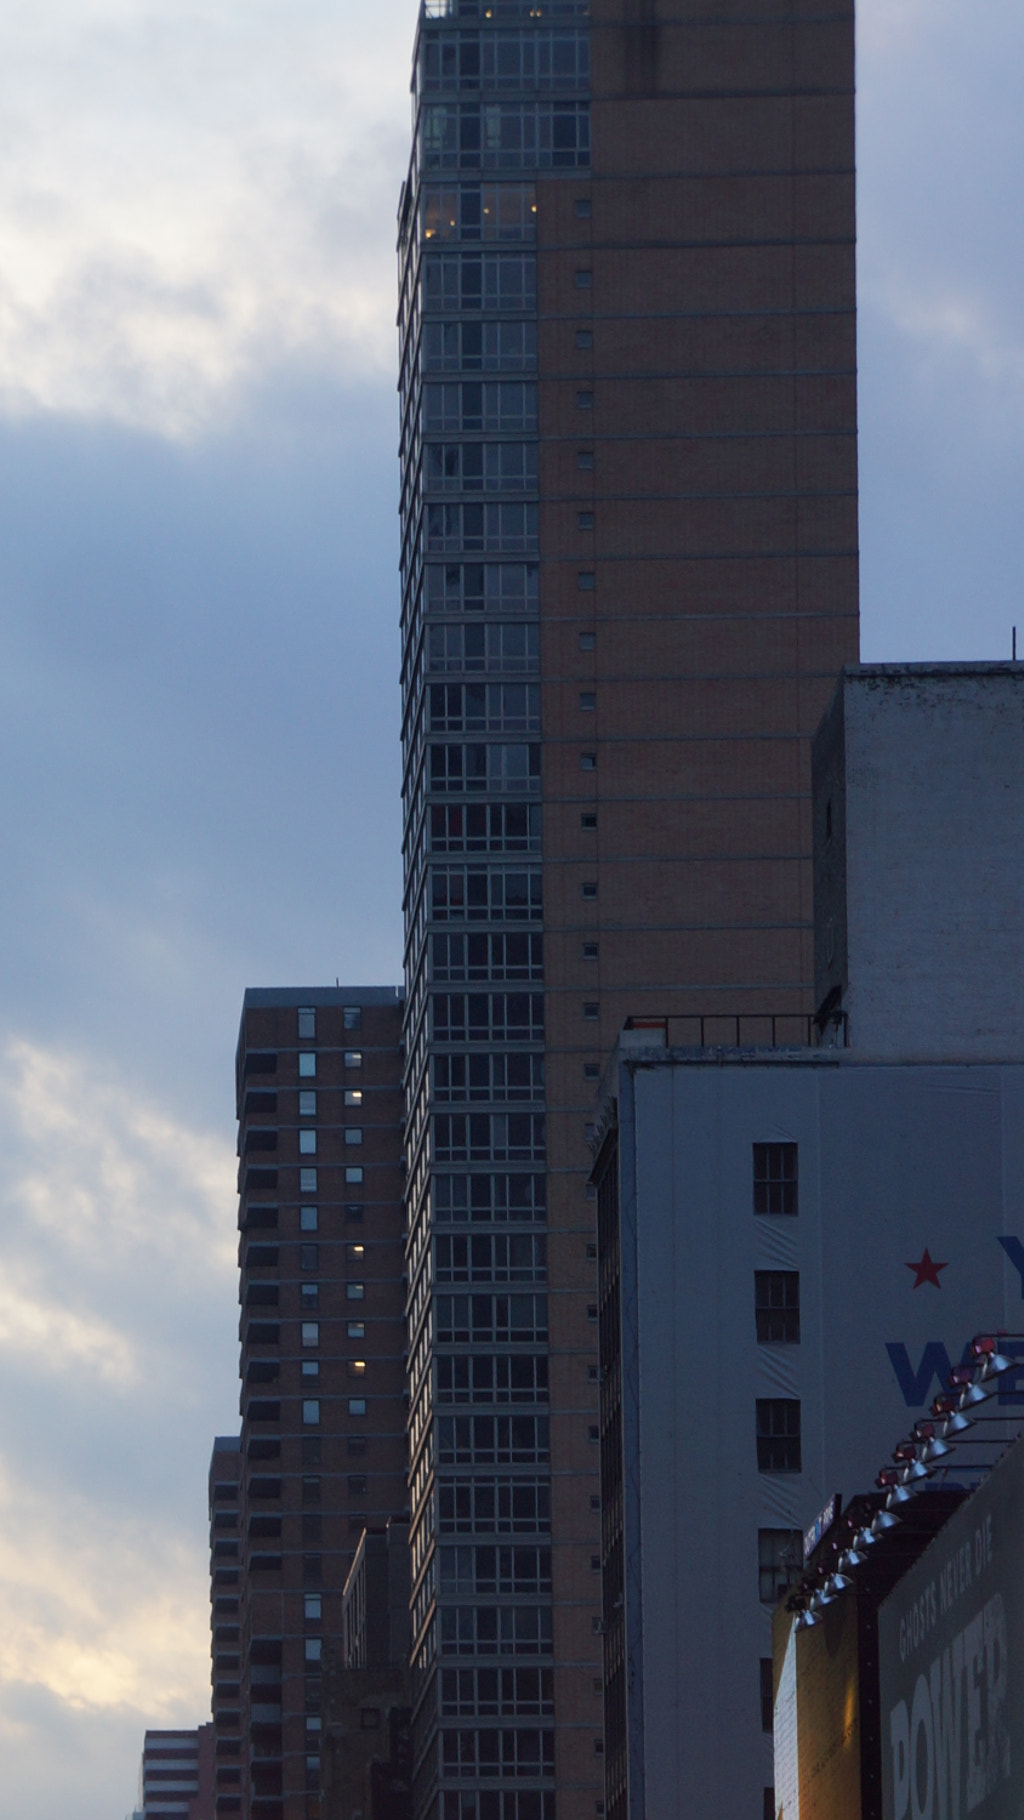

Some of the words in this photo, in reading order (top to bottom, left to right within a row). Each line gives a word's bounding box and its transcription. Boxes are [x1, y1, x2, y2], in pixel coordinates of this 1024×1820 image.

[899, 1580, 937, 1662] GHOSTS
[939, 1541, 972, 1617] NEVER
[974, 1513, 993, 1577] DIE
